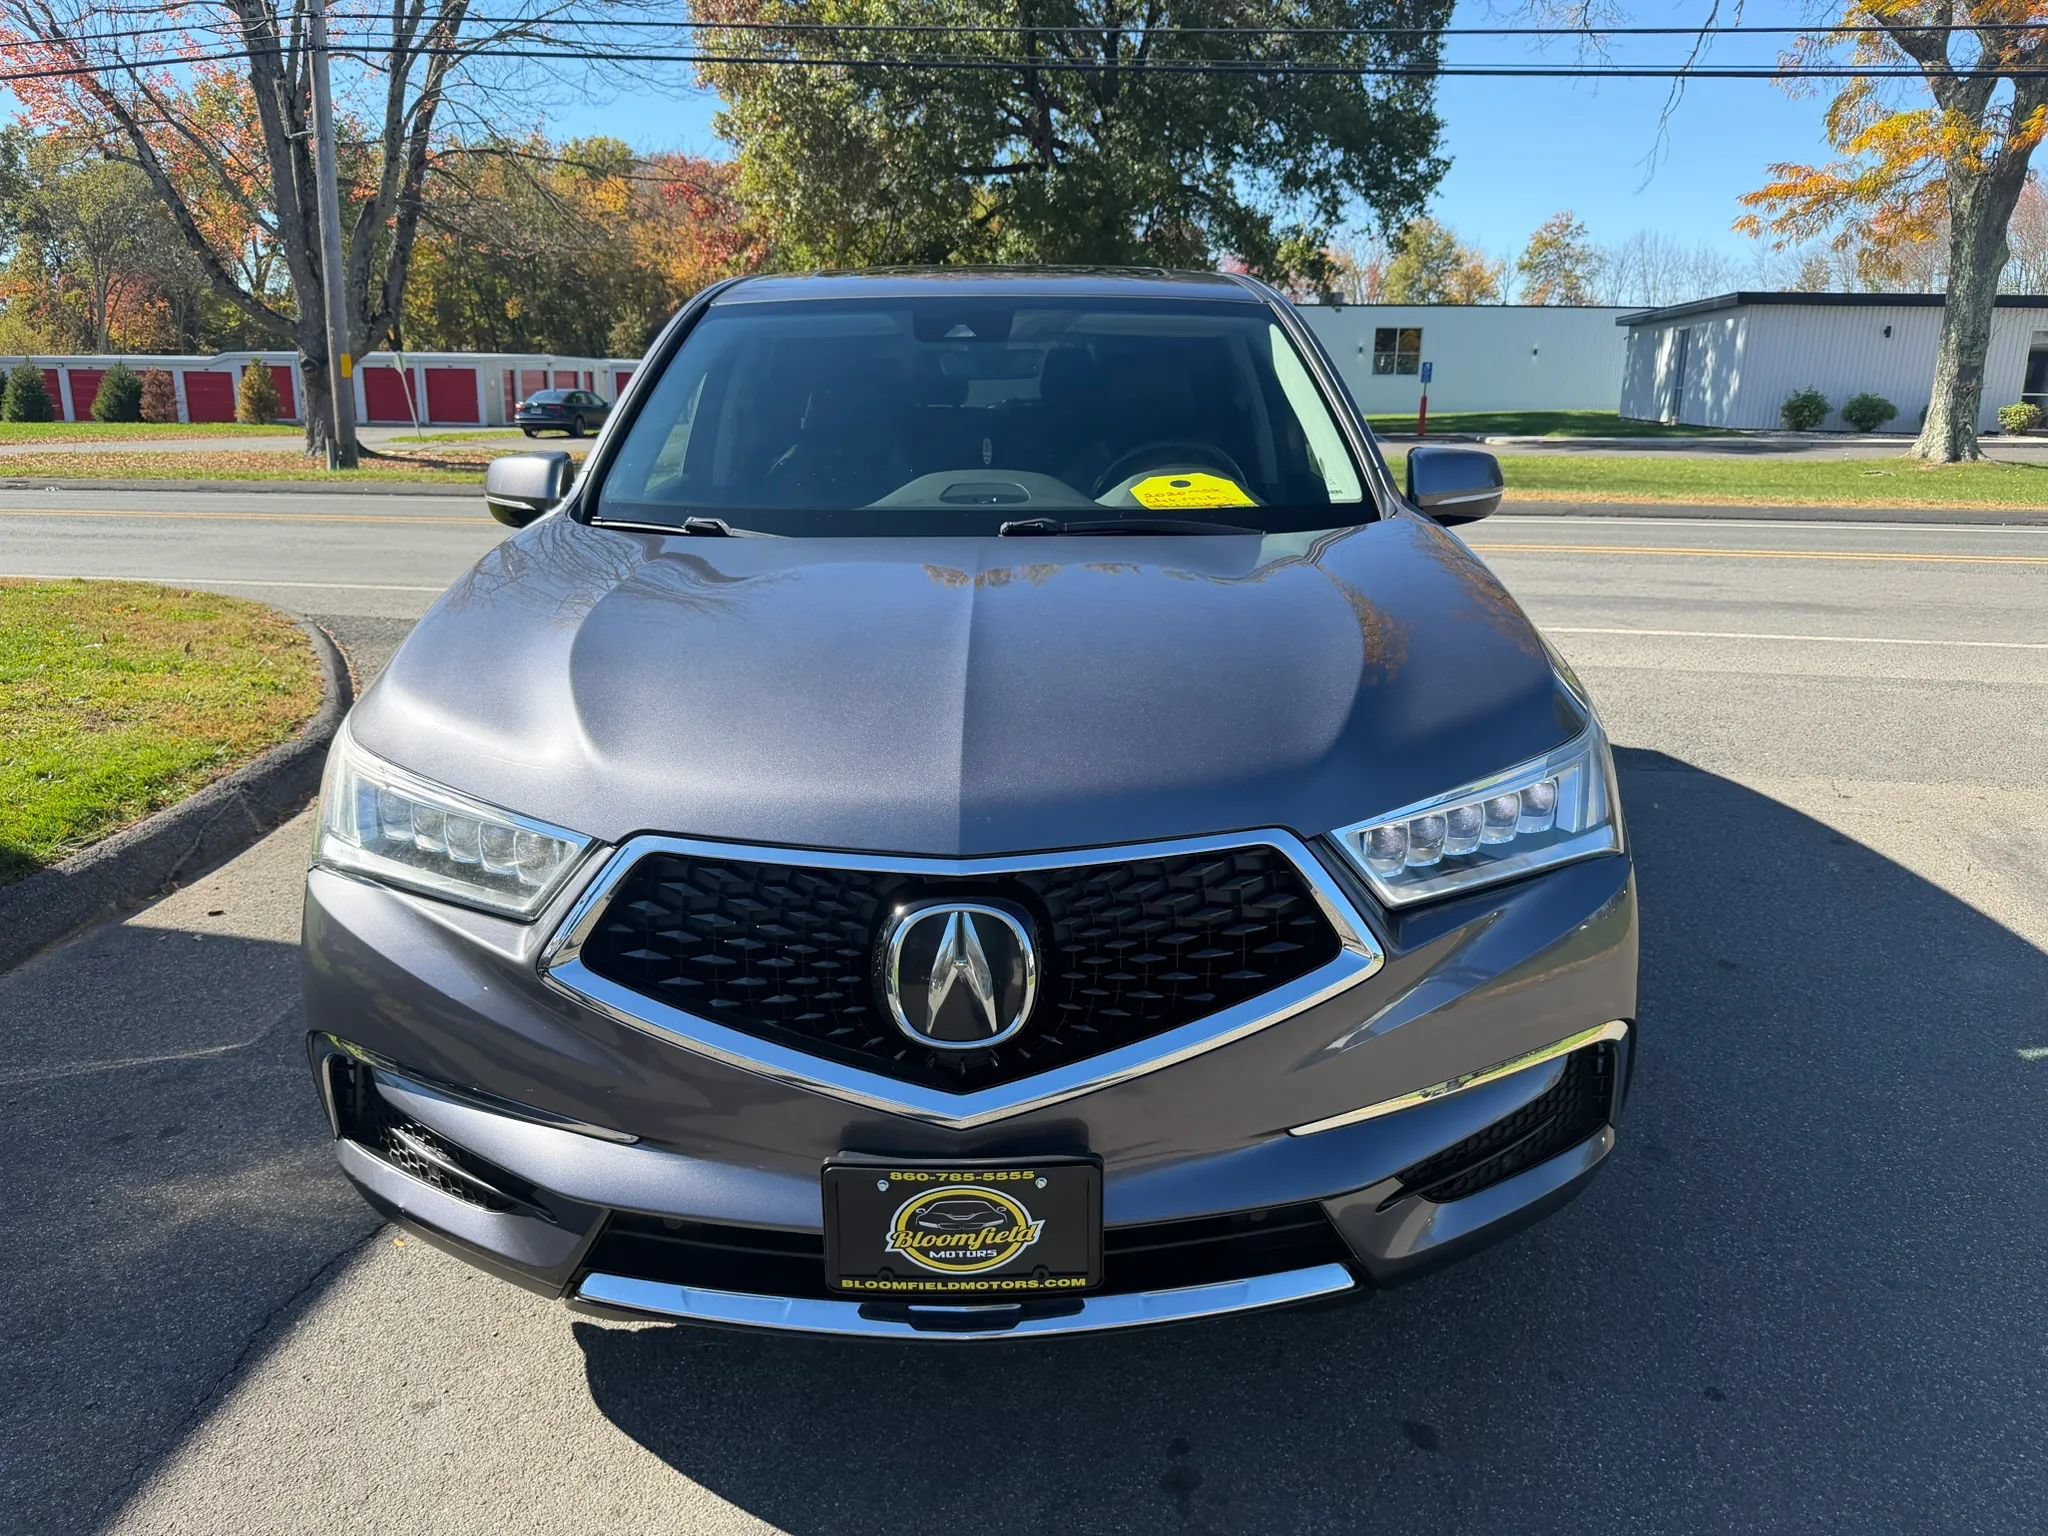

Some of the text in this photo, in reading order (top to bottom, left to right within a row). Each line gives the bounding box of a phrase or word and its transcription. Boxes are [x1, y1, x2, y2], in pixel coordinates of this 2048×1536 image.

[889, 1170, 1035, 1182] 860-785-5555
[891, 1224, 1038, 1249] Bloomfield
[929, 1249, 998, 1259] MOTORS
[841, 1278, 1086, 1292] BLOOMFIELDMOTORS.COM
